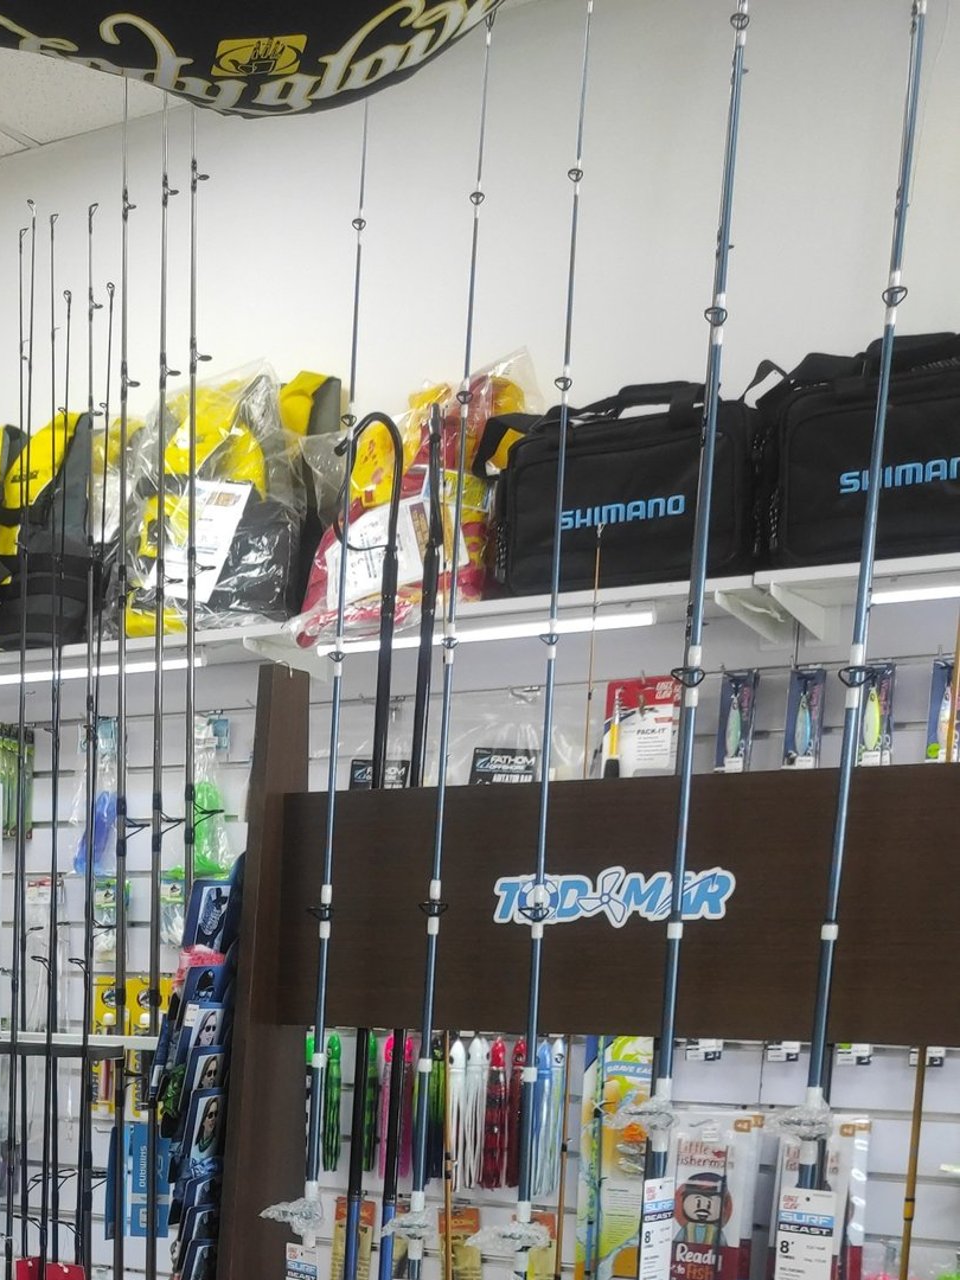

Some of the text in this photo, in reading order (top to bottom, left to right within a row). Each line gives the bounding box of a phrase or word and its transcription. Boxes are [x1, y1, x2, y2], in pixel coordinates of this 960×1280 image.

[560, 493, 686, 531] SHIMANO
[489, 755, 536, 766] FATHOM
[138, 1145, 148, 1188] SHIMANO
[644, 1202, 674, 1212] SURF
[644, 1211, 673, 1222] BEAST
[780, 1211, 831, 1225] SURF
[779, 1223, 831, 1236] BEAST
[287, 1261, 317, 1275] SURF
